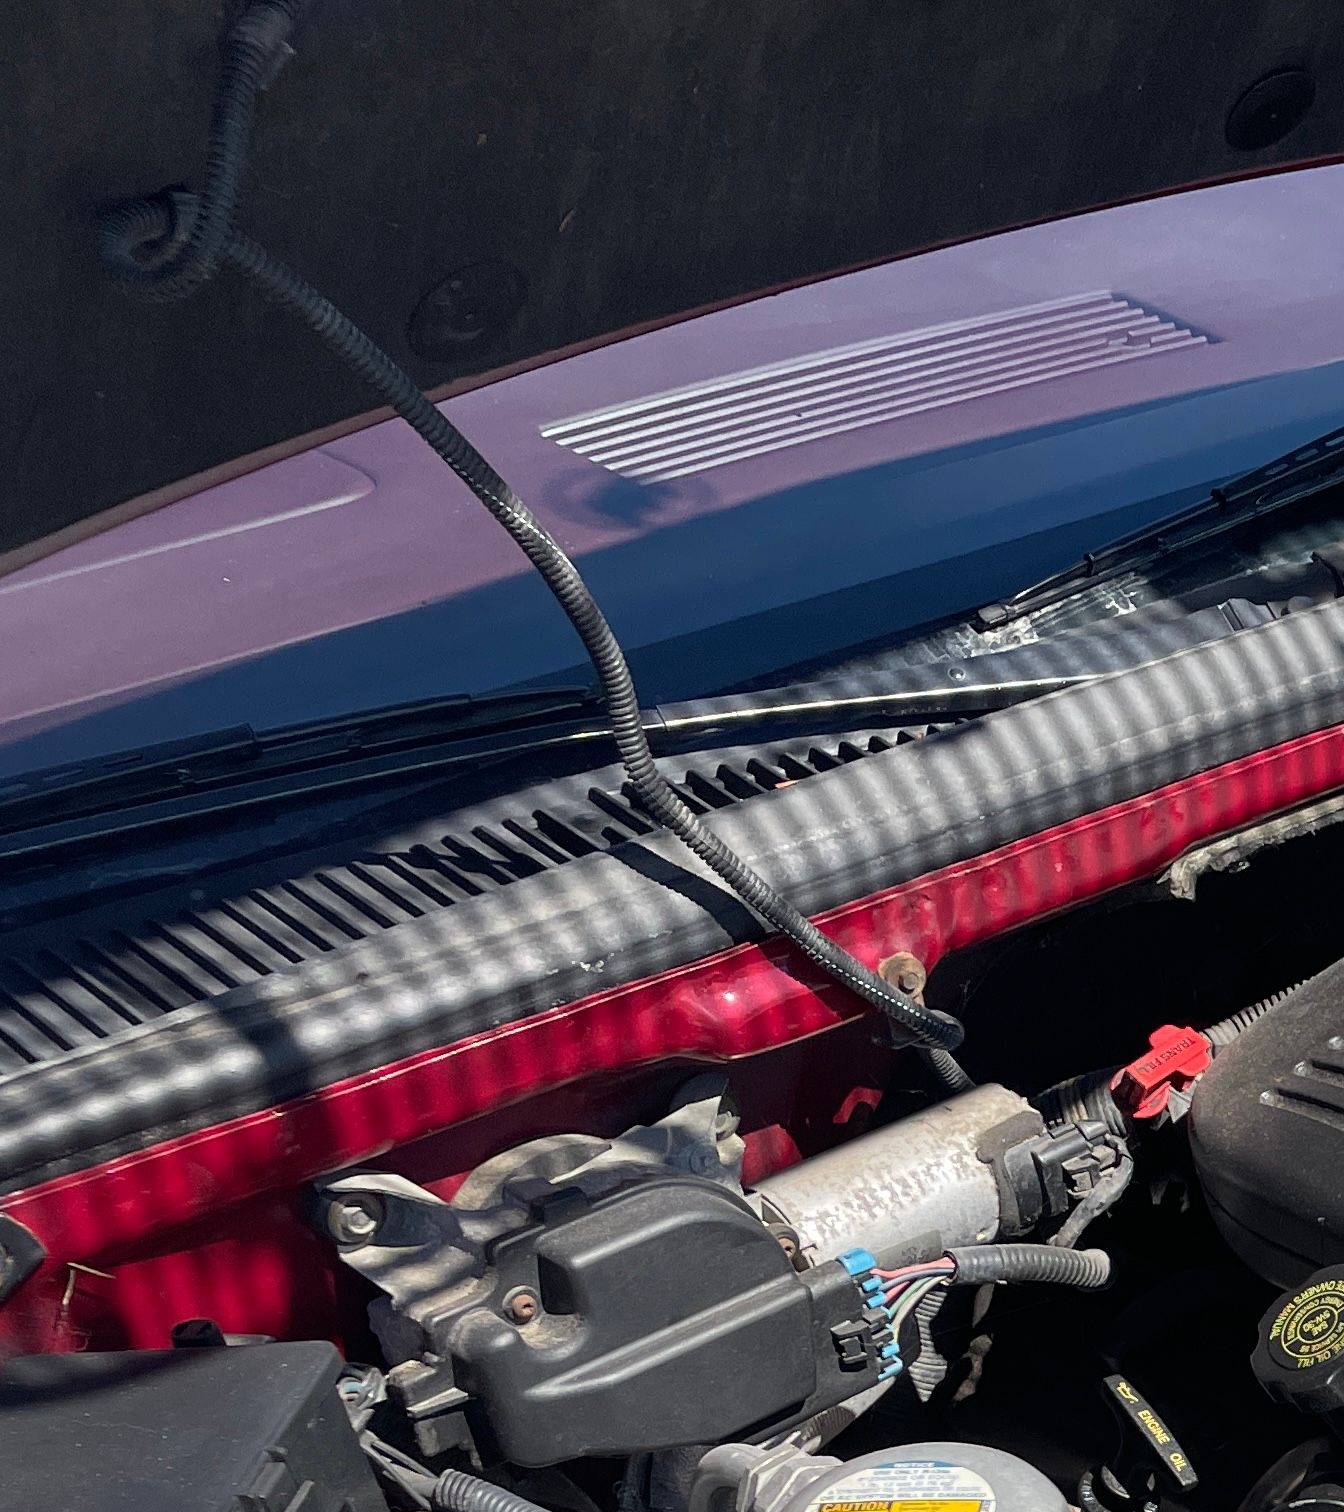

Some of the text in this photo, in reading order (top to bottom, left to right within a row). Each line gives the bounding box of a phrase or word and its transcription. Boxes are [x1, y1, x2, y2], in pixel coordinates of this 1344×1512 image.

[1293, 1280, 1336, 1304] OWNER'S
[1269, 1303, 1296, 1340] MANUAL
[1302, 1310, 1332, 1333] 5W-30
[1311, 1320, 1329, 1336] SAE
[1296, 1357, 1315, 1369] FILL
[1315, 1351, 1331, 1363] OIL
[1137, 1409, 1185, 1472] ENGINE OIL
[821, 1501, 889, 1512] CAUTION
